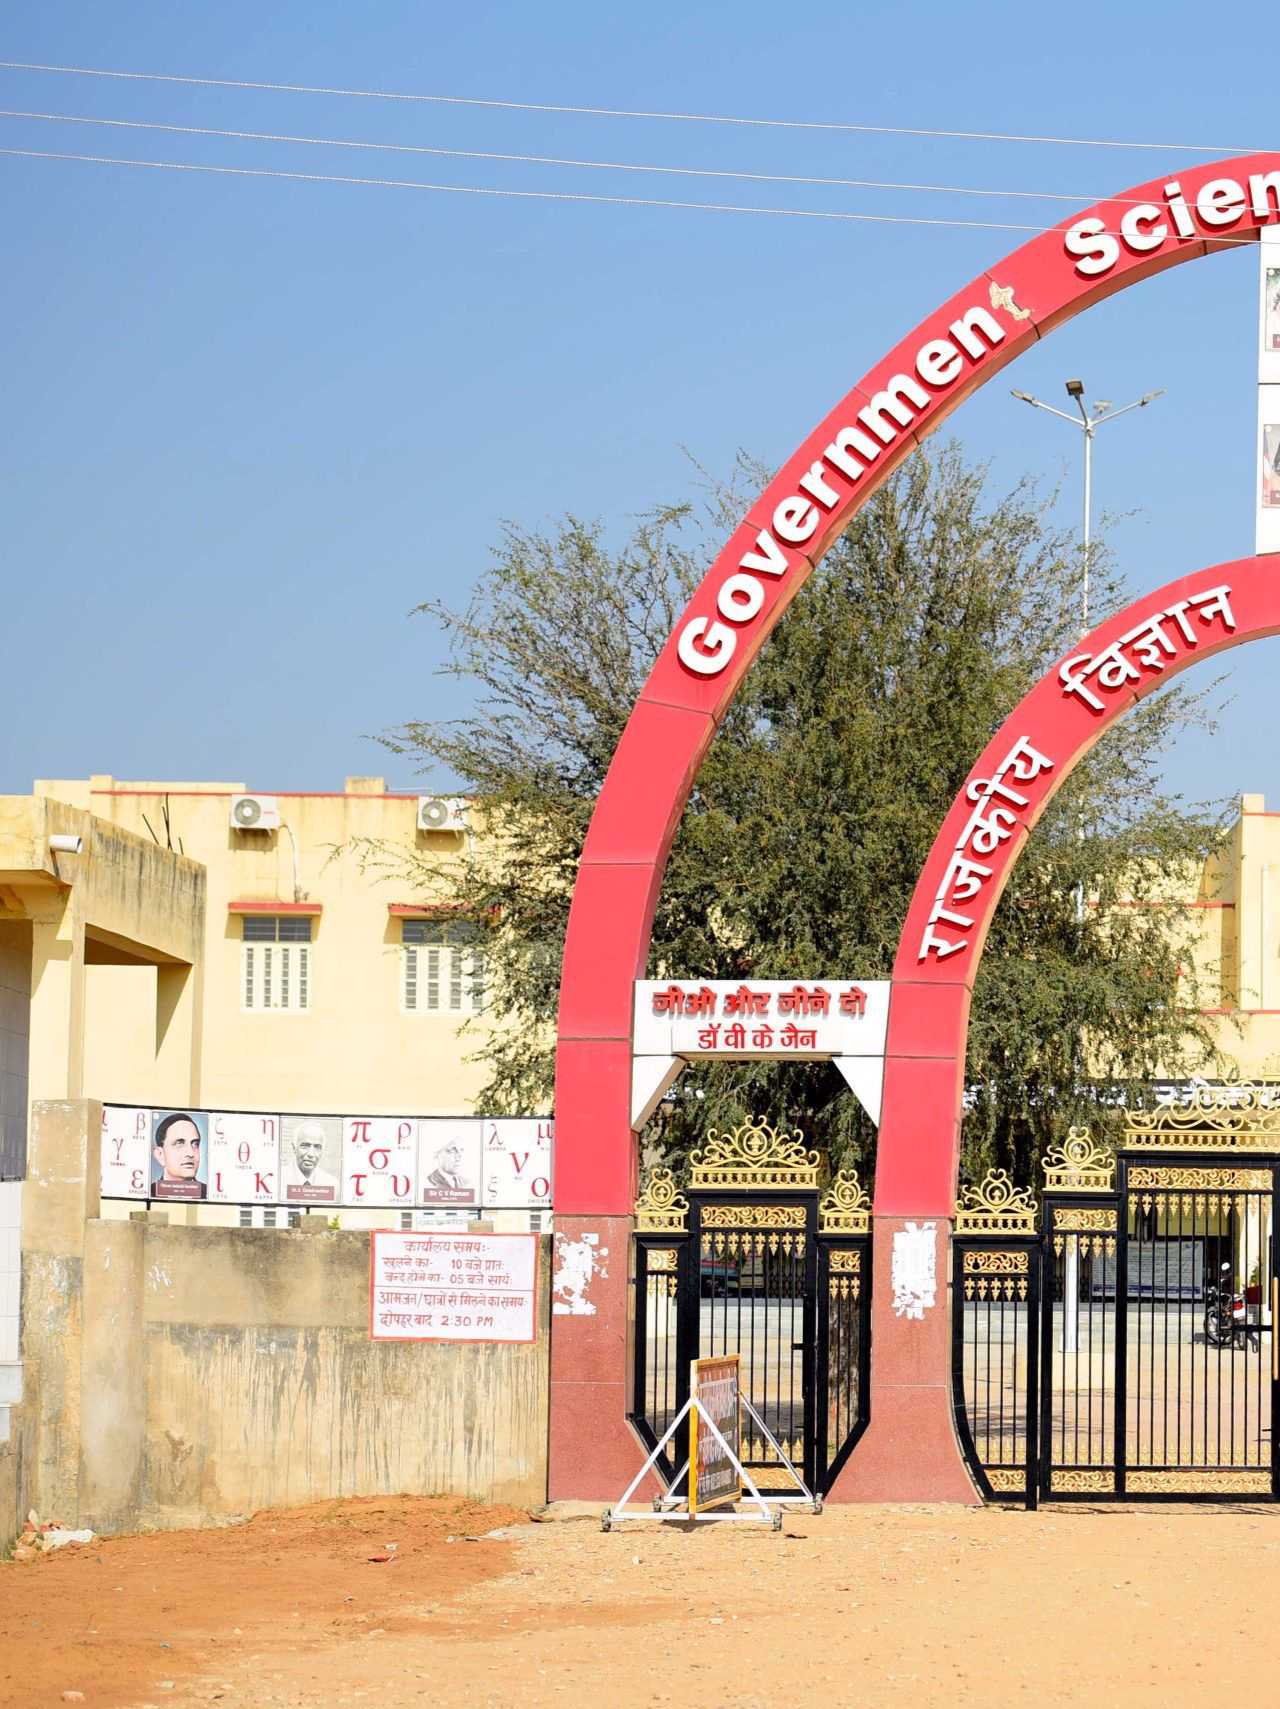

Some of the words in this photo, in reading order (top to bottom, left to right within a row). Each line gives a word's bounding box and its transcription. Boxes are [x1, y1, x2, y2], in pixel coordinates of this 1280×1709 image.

[918, 736, 1054, 959] राजकीय
[1058, 584, 1236, 710] विज्ञान
[724, 985, 771, 1015] और
[778, 985, 831, 1015] जीने
[839, 986, 867, 1015] दो
[698, 1023, 721, 1049] डॉ
[724, 1023, 746, 1049] वी
[752, 1023, 775, 1049] के
[780, 1023, 817, 1049] जैन
[451, 1259, 462, 1269] 10
[449, 1274, 464, 1284] 05
[441, 1315, 471, 1326] 2:30
[477, 1315, 494, 1327] PM
